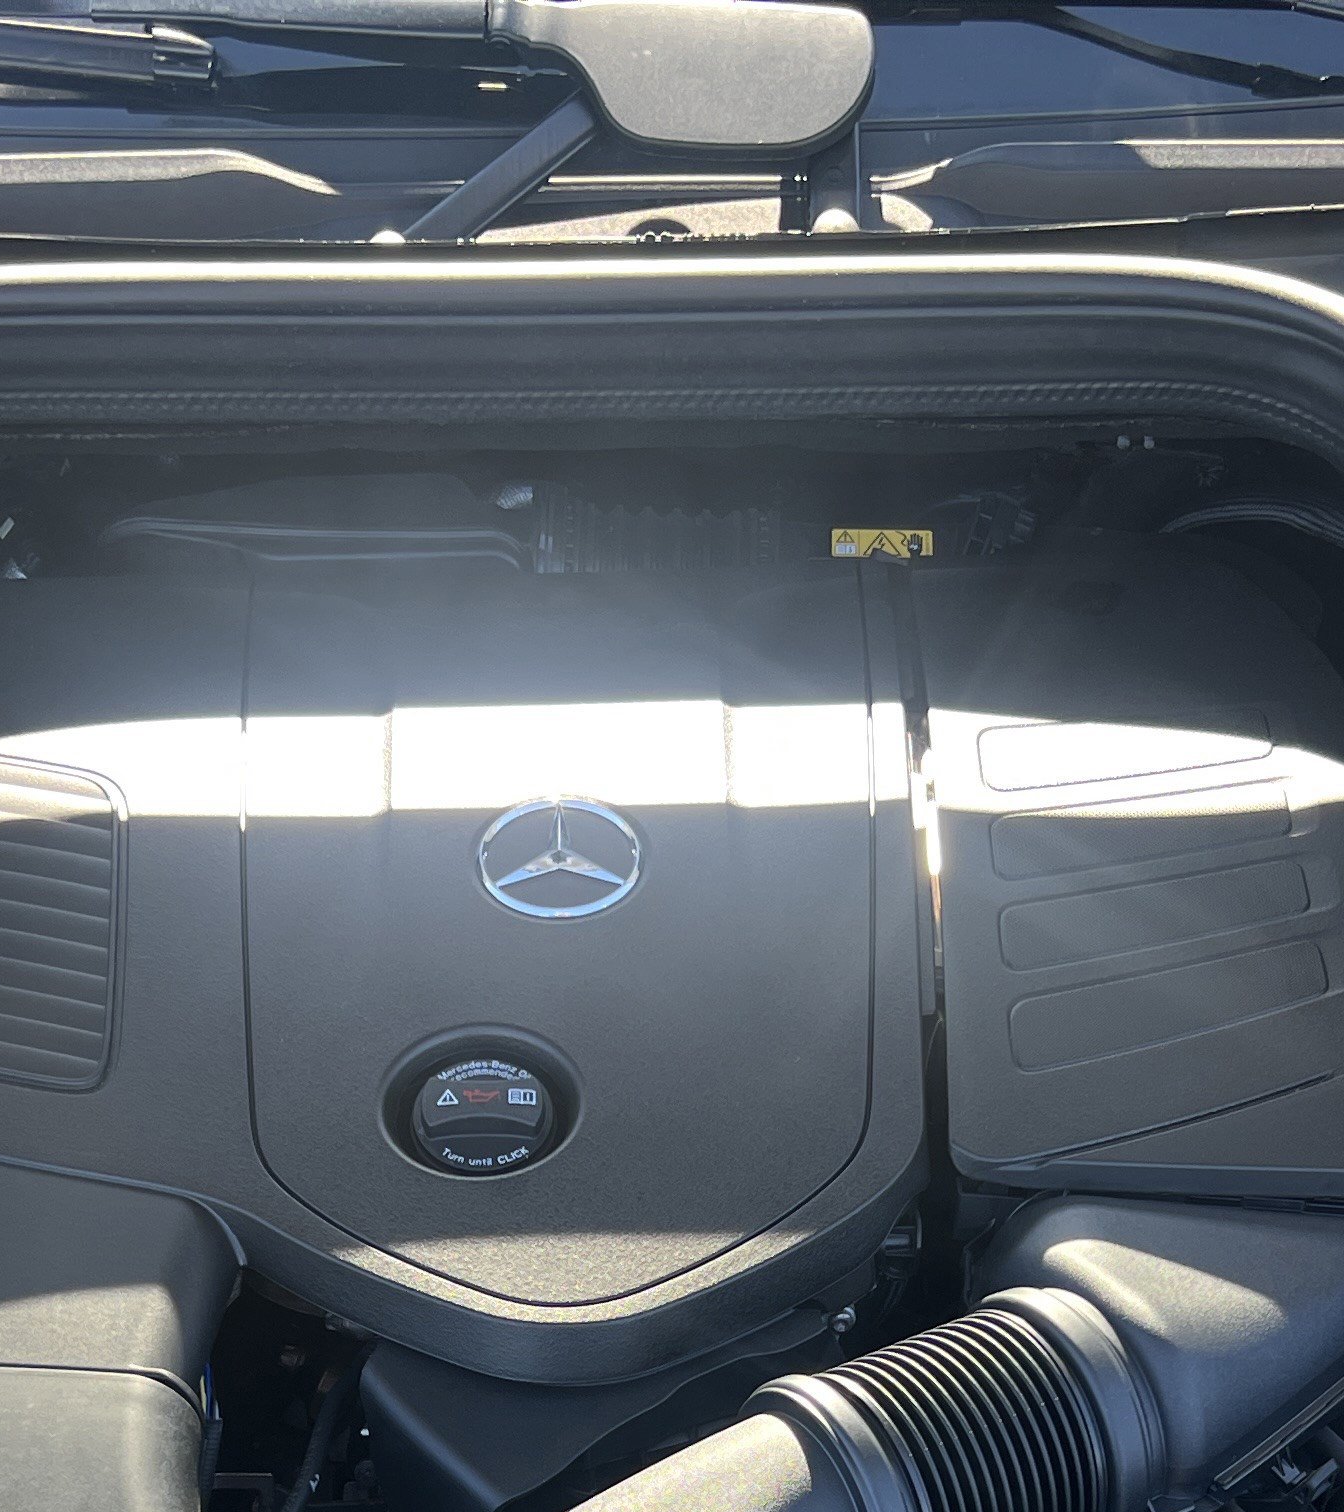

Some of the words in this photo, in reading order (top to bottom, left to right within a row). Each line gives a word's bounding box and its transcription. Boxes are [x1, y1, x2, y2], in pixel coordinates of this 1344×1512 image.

[442, 1148, 465, 1164] Turn
[468, 1157, 493, 1166] until
[497, 1146, 529, 1165] CLICK
